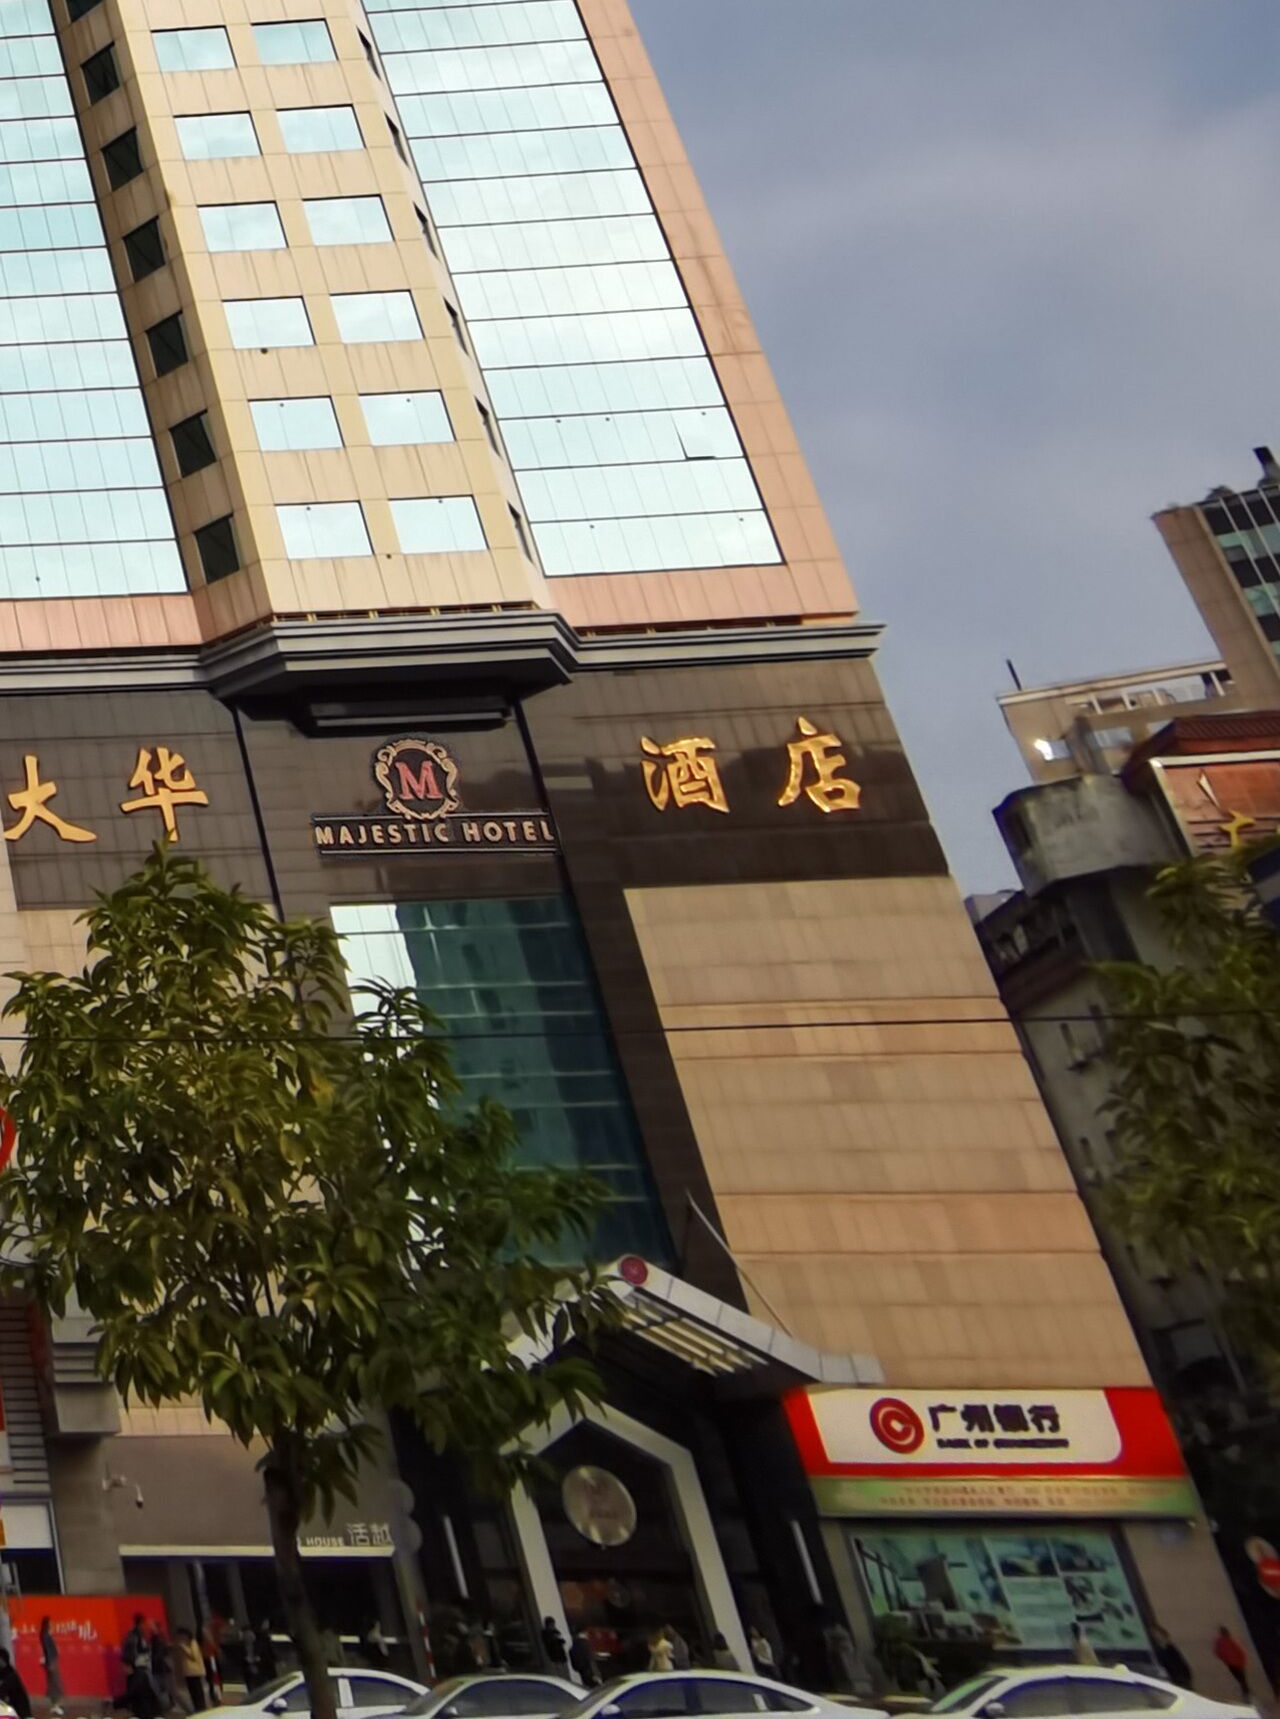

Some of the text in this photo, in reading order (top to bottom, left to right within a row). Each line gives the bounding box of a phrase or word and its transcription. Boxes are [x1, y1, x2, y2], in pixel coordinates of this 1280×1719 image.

[640, 716, 862, 813] 酒店
[314, 820, 554, 845] MAJESTIC HOTEL
